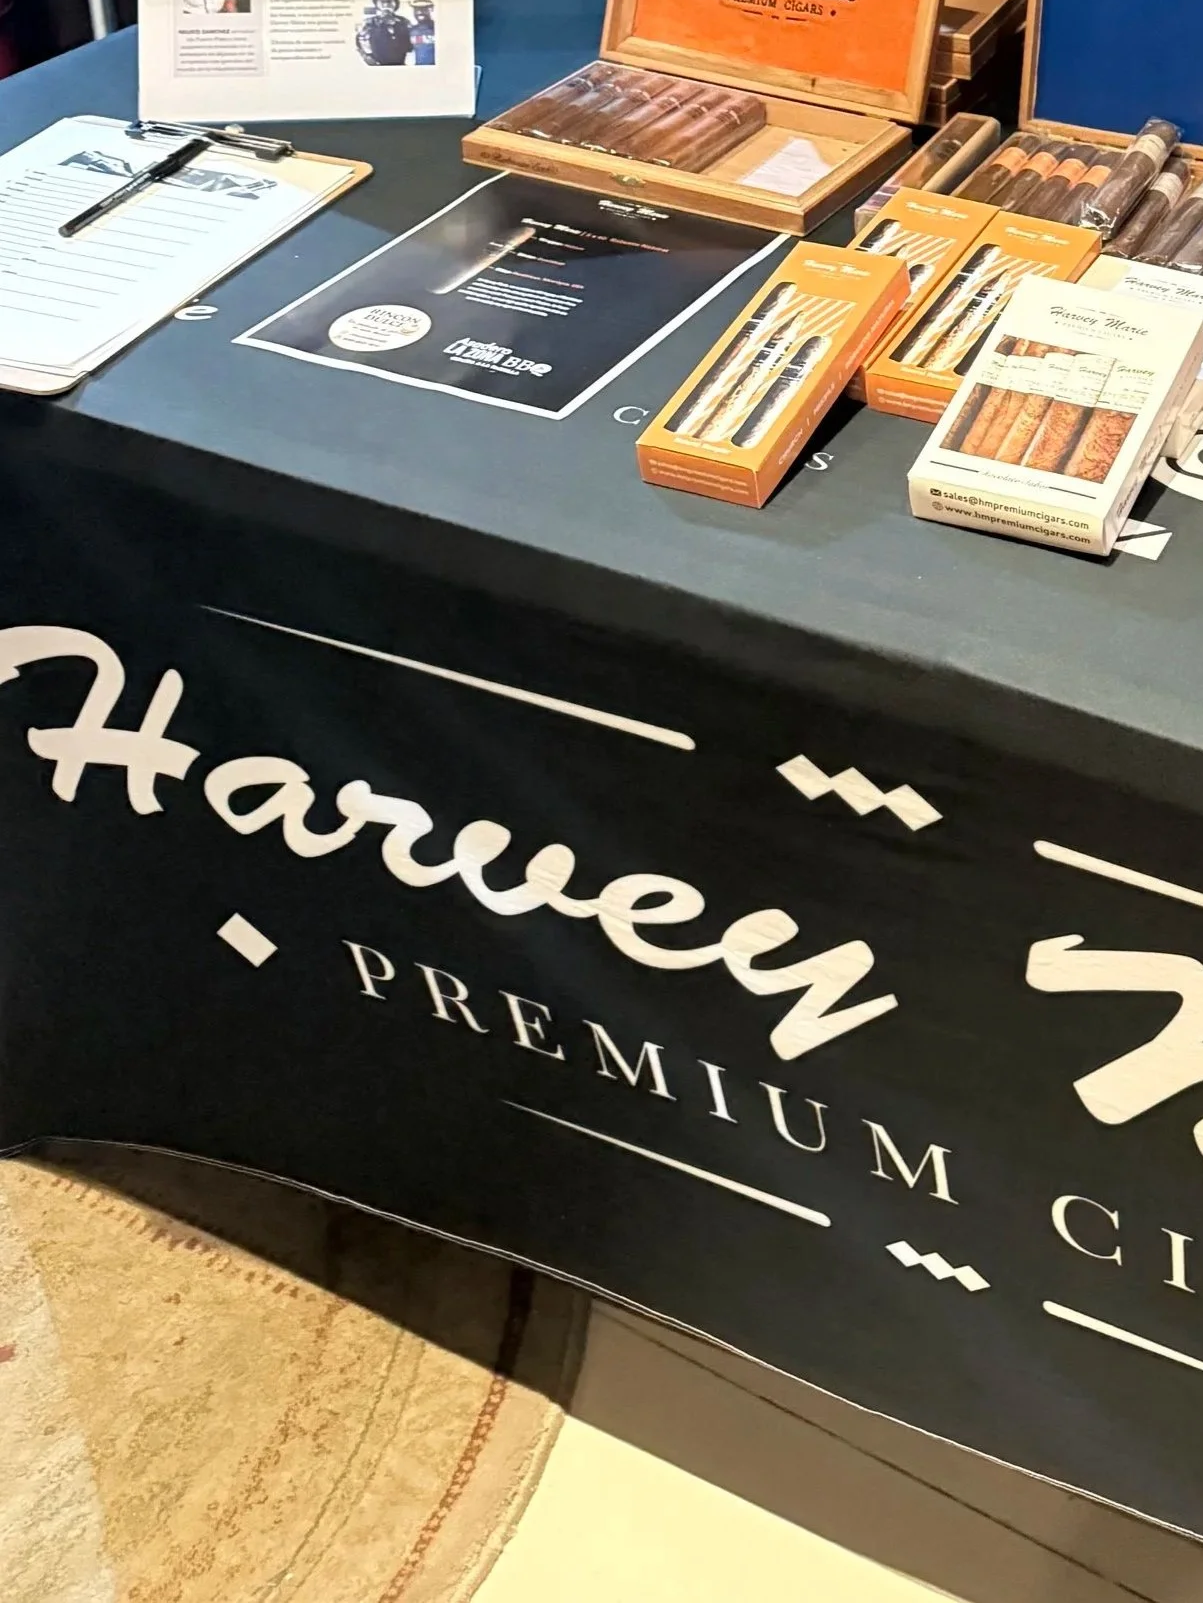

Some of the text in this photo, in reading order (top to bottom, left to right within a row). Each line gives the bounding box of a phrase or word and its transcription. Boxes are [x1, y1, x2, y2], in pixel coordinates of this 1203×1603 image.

[783, 0, 823, 16] CIGARS
[1124, 276, 1171, 293] Harvey
[1050, 305, 1150, 336] Harvey Marie
[501, 356, 553, 377] BBQ
[942, 490, 1090, 531] sales@hmpremiumcigars.com
[944, 504, 1092, 545] www.hmpremiumcigars.com
[0, 624, 898, 1063] Harvey
[342, 938, 960, 1205] PREMIUM
